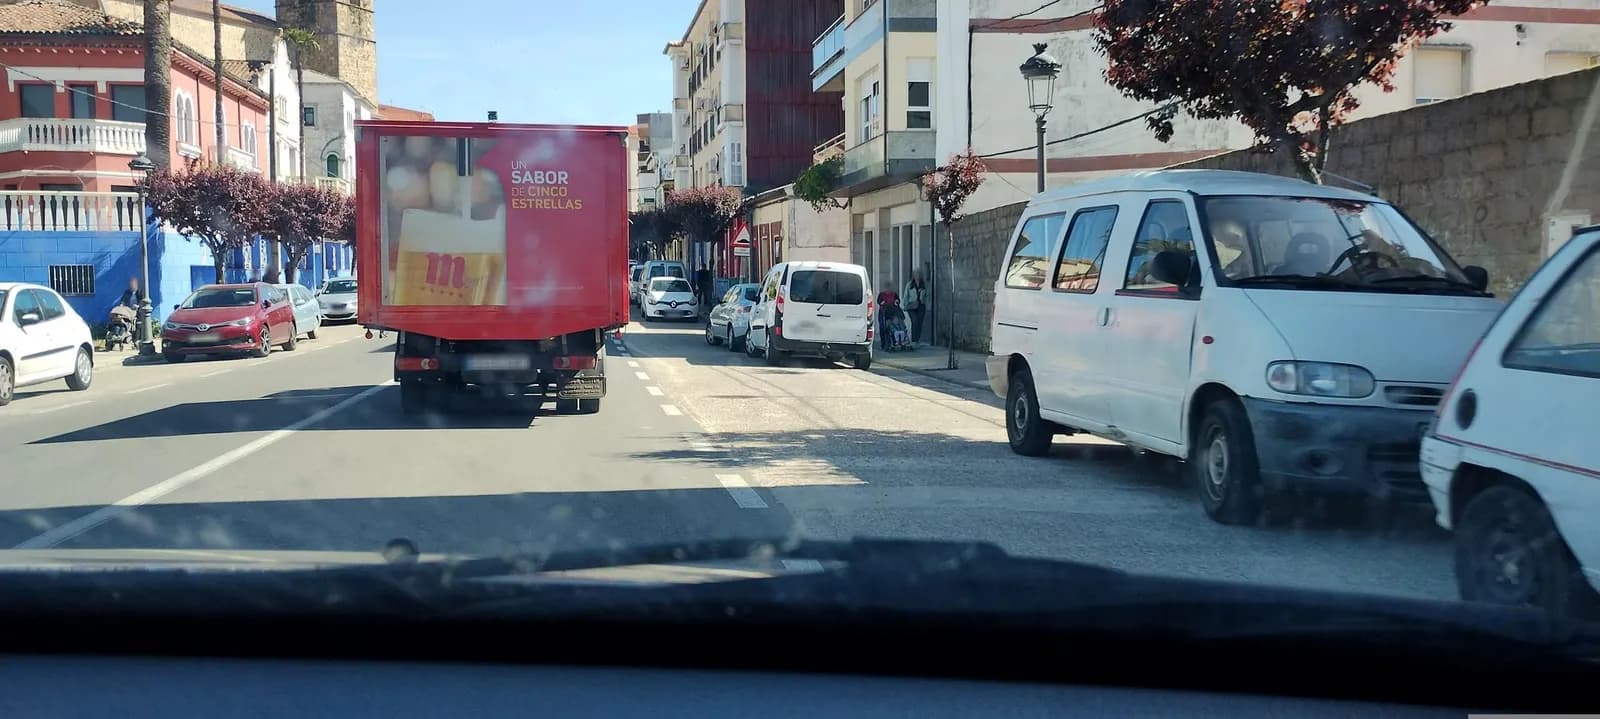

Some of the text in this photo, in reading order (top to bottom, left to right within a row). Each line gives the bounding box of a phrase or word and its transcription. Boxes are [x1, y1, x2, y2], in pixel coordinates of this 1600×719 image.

[511, 160, 527, 170] UN
[511, 170, 569, 185] SABOR
[511, 186, 568, 197] DE CINCO
[512, 198, 583, 210] ESTRELLAS
